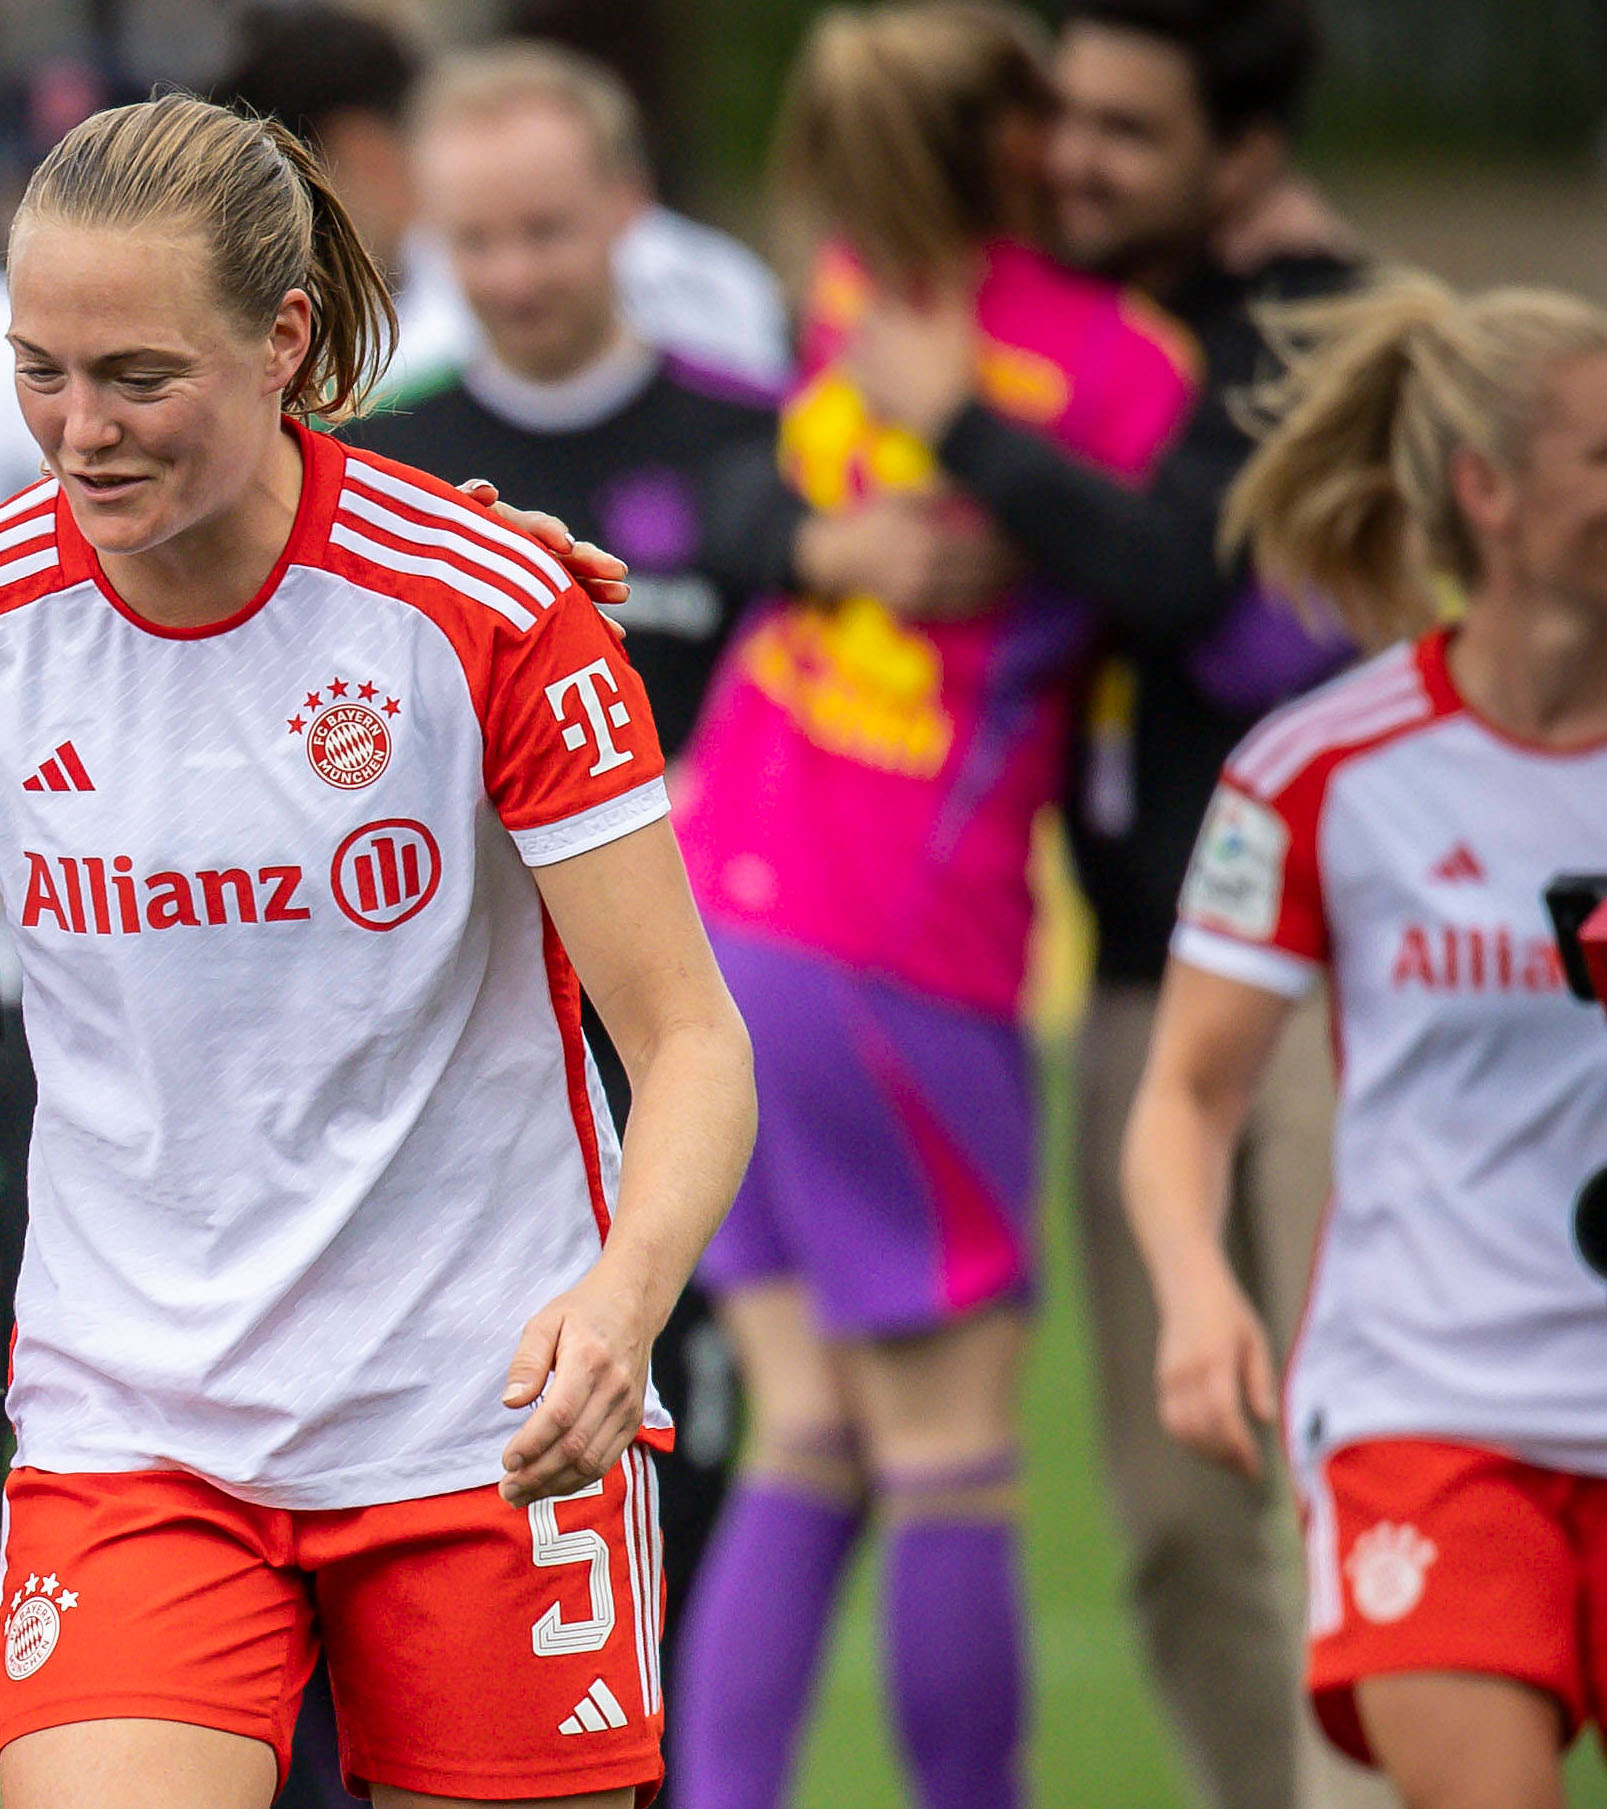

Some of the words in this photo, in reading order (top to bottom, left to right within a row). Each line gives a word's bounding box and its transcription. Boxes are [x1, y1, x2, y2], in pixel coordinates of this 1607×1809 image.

[314, 727, 328, 746] FC
[326, 709, 382, 737] BAYERN
[318, 749, 385, 784] MÜNCHEN
[23, 851, 311, 935] Allianz
[528, 1480, 615, 1657] 5
